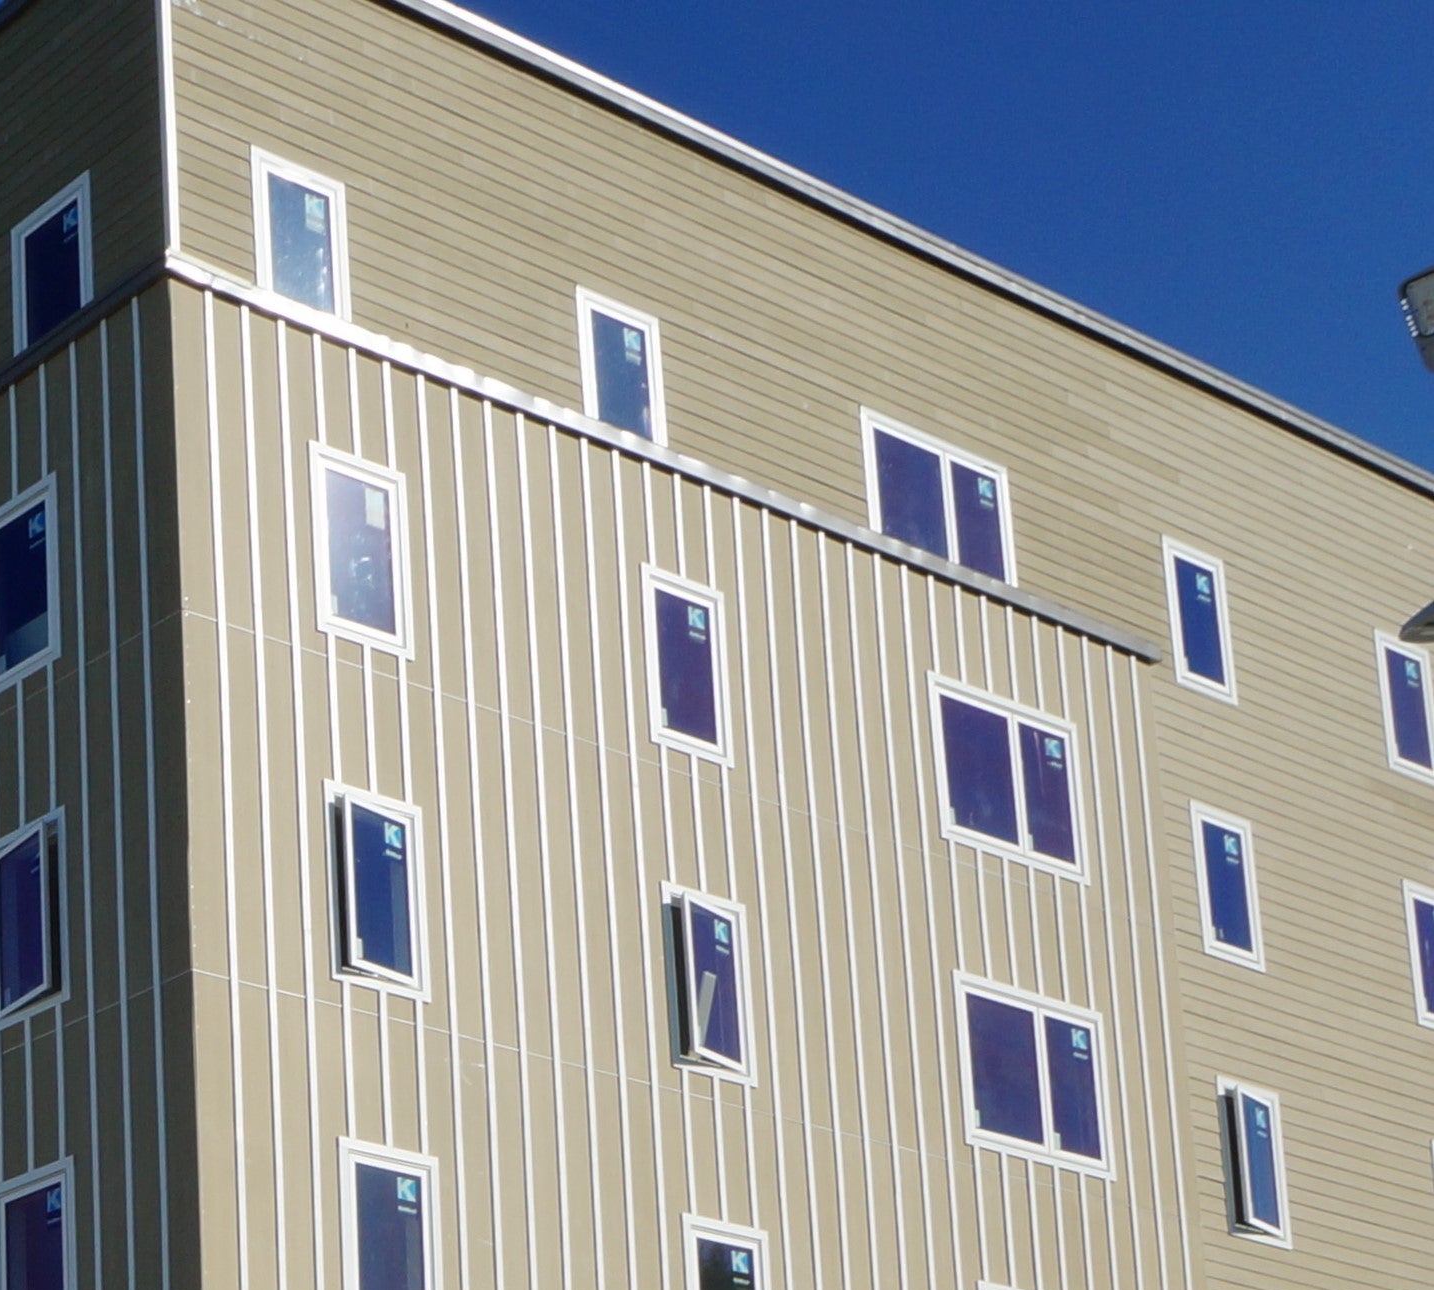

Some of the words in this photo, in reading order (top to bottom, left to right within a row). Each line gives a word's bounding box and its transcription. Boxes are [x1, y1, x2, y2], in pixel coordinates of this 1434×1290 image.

[688, 606, 705, 630] K
[384, 821, 402, 849] K
[714, 919, 729, 943] K
[397, 1177, 416, 1202] K
[731, 1250, 749, 1274] K
